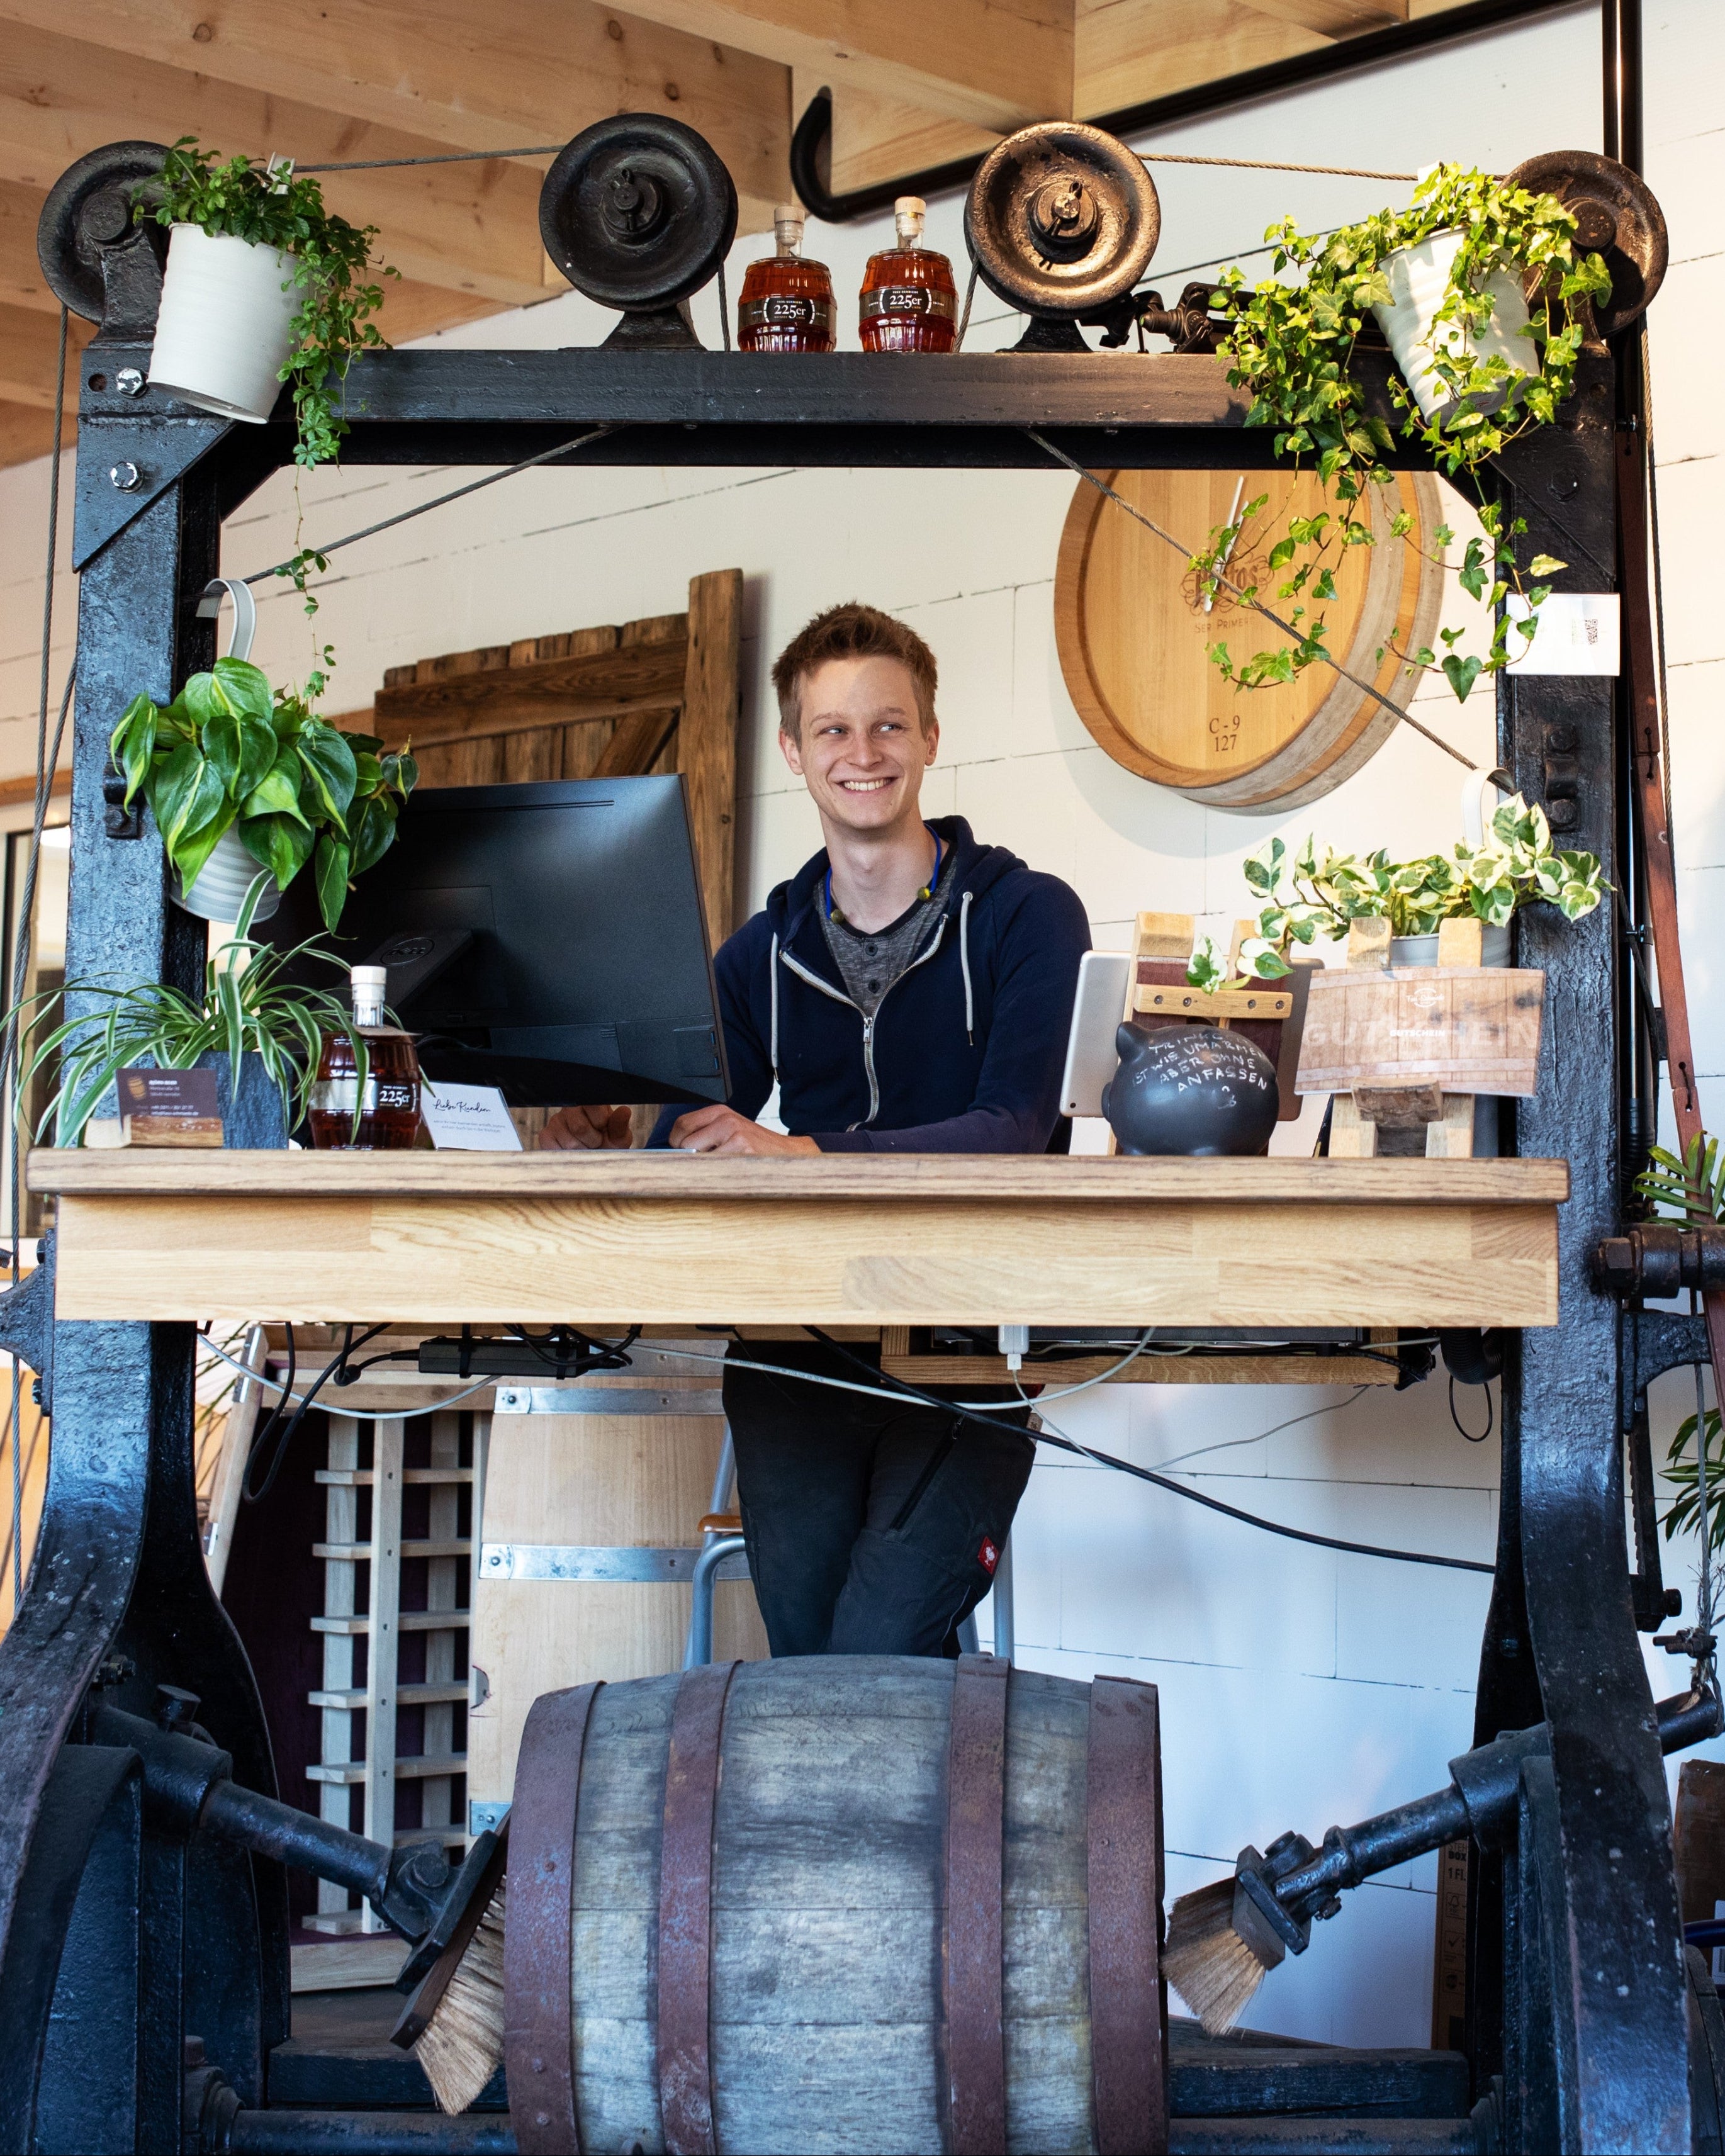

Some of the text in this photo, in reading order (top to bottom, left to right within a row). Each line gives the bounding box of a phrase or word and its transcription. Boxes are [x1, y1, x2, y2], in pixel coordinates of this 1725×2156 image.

[889, 295, 922, 309] 225er
[773, 305, 806, 319] 225er
[1215, 734, 1237, 752] 127
[1389, 1029, 1446, 1038] GUTSCHEIN
[1150, 1051, 1179, 1071] WIE
[1160, 1053, 1256, 1084] ABER OHNE
[1177, 1065, 1267, 1094] ANFASSEN
[379, 1090, 410, 1108] 225er
[433, 1099, 456, 1111] Liebe
[1449, 1851, 1466, 1861] BOX
[1448, 1867, 1452, 1879] 1
